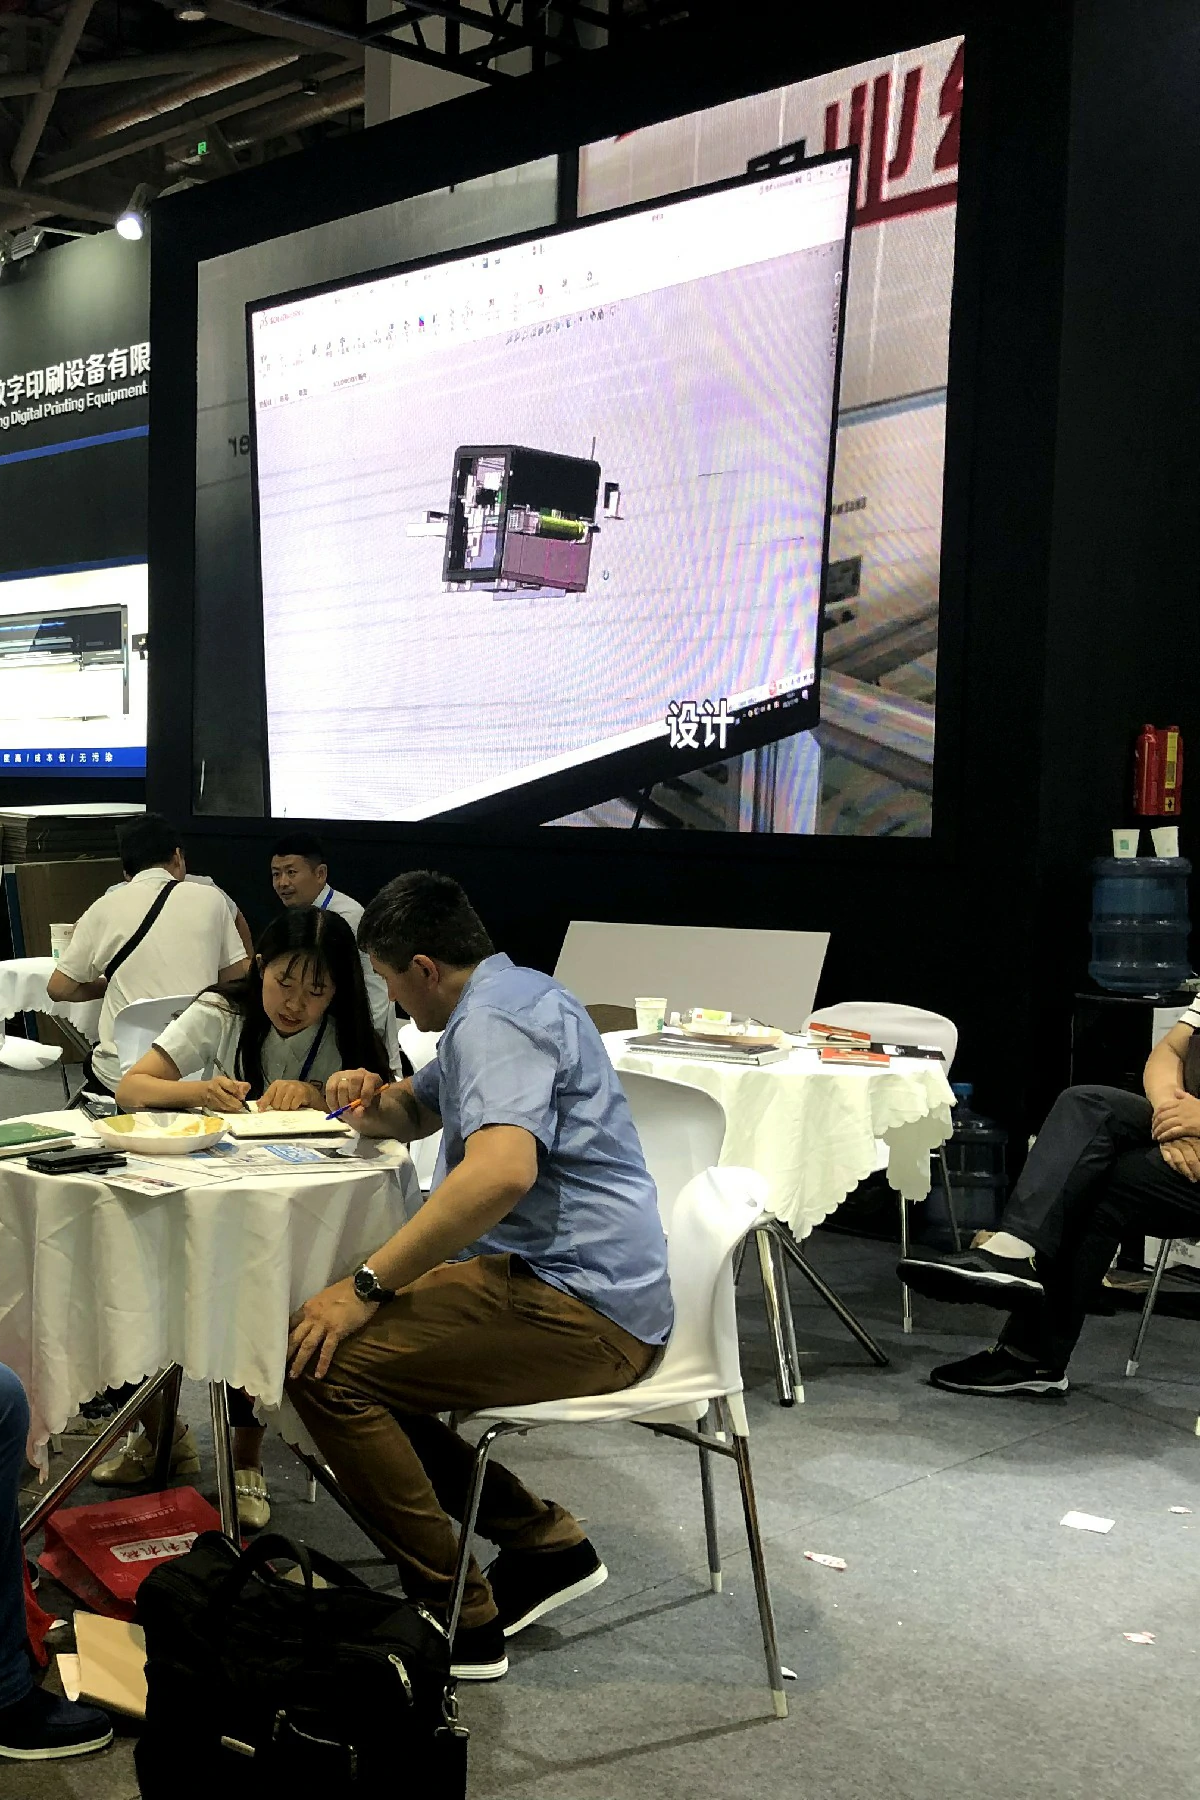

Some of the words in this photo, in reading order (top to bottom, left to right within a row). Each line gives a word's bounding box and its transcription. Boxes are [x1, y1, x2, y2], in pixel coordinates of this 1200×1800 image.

[11, 405, 42, 425] Digital
[44, 398, 84, 417] Printing
[86, 380, 148, 408] Equipment
[666, 698, 736, 749] 设计
